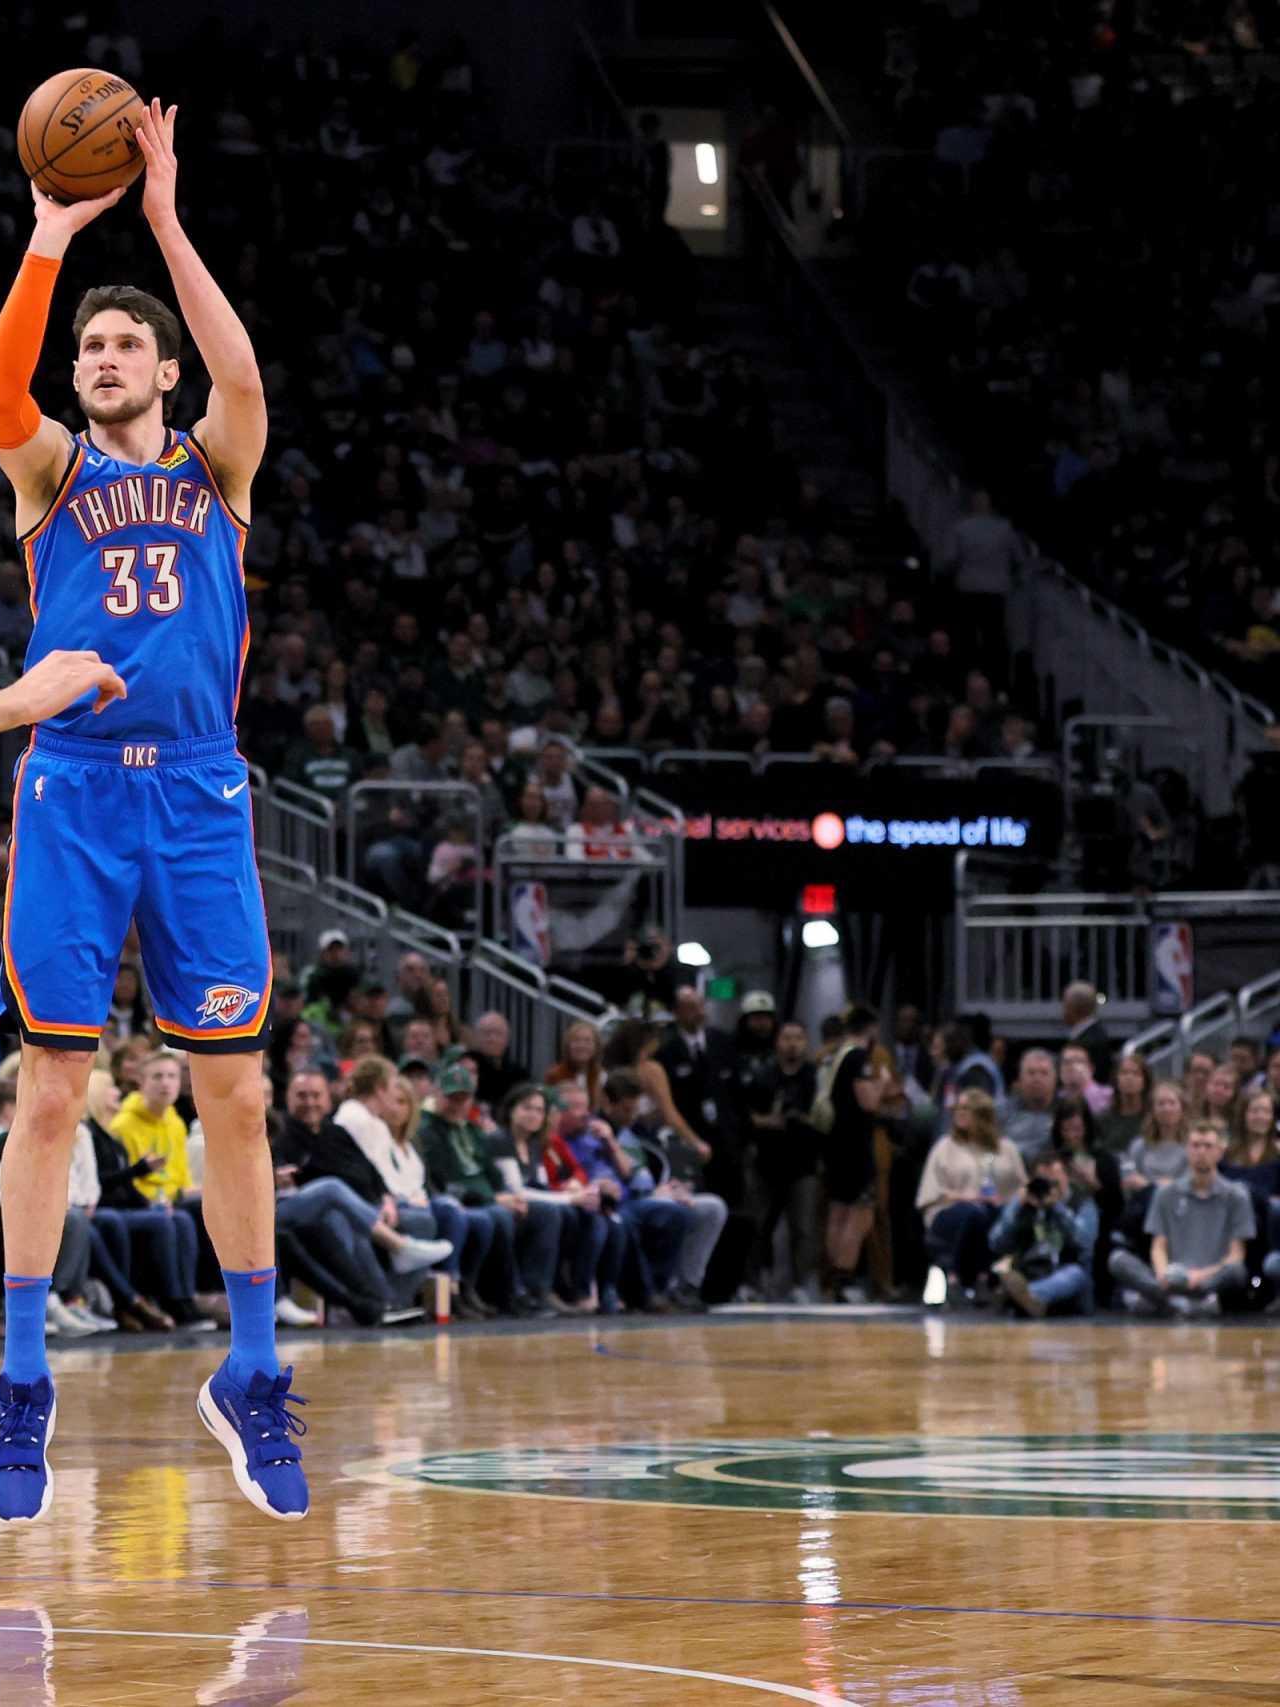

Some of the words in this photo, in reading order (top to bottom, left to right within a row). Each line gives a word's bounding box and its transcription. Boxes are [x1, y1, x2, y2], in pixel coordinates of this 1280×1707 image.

[68, 475, 213, 544] THUNDER
[101, 542, 183, 617] 33
[122, 745, 158, 767] OKC
[715, 816, 811, 841] services
[845, 815, 887, 843] the
[887, 817, 960, 849] speed
[961, 815, 989, 846] of
[989, 816, 1026, 847] life
[206, 993, 240, 1016] OKC
